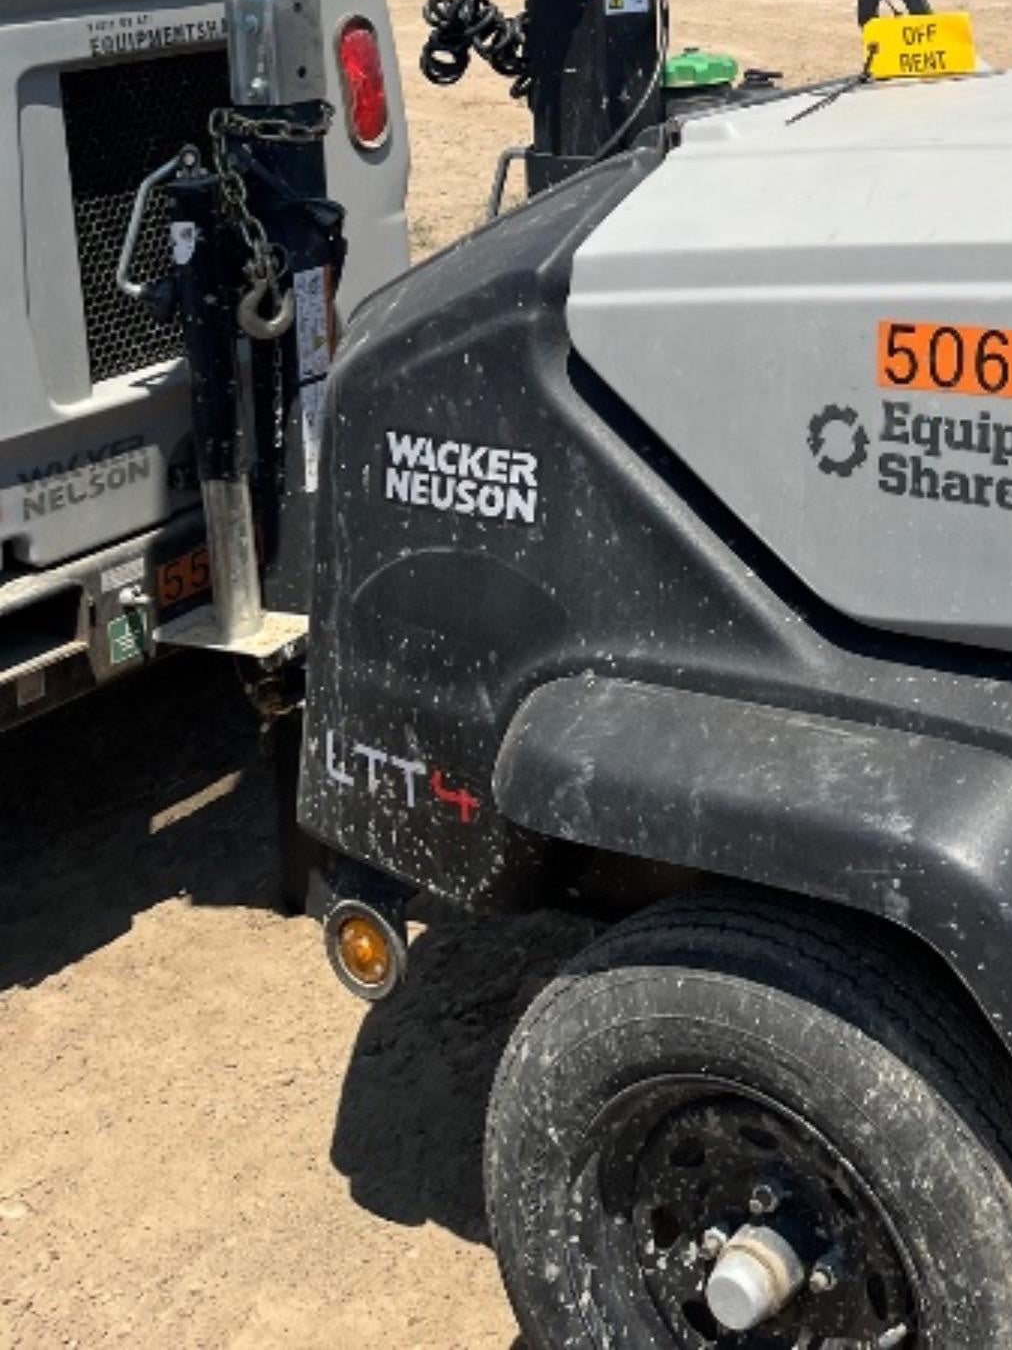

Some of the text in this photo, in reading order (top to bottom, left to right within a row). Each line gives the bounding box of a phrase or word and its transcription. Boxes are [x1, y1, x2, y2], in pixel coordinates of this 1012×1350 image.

[900, 51, 947, 73] RENT
[902, 23, 937, 46] OFF
[383, 430, 539, 487] WACKER
[385, 467, 538, 523] NEUSON
[325, 728, 481, 824] LTT4
